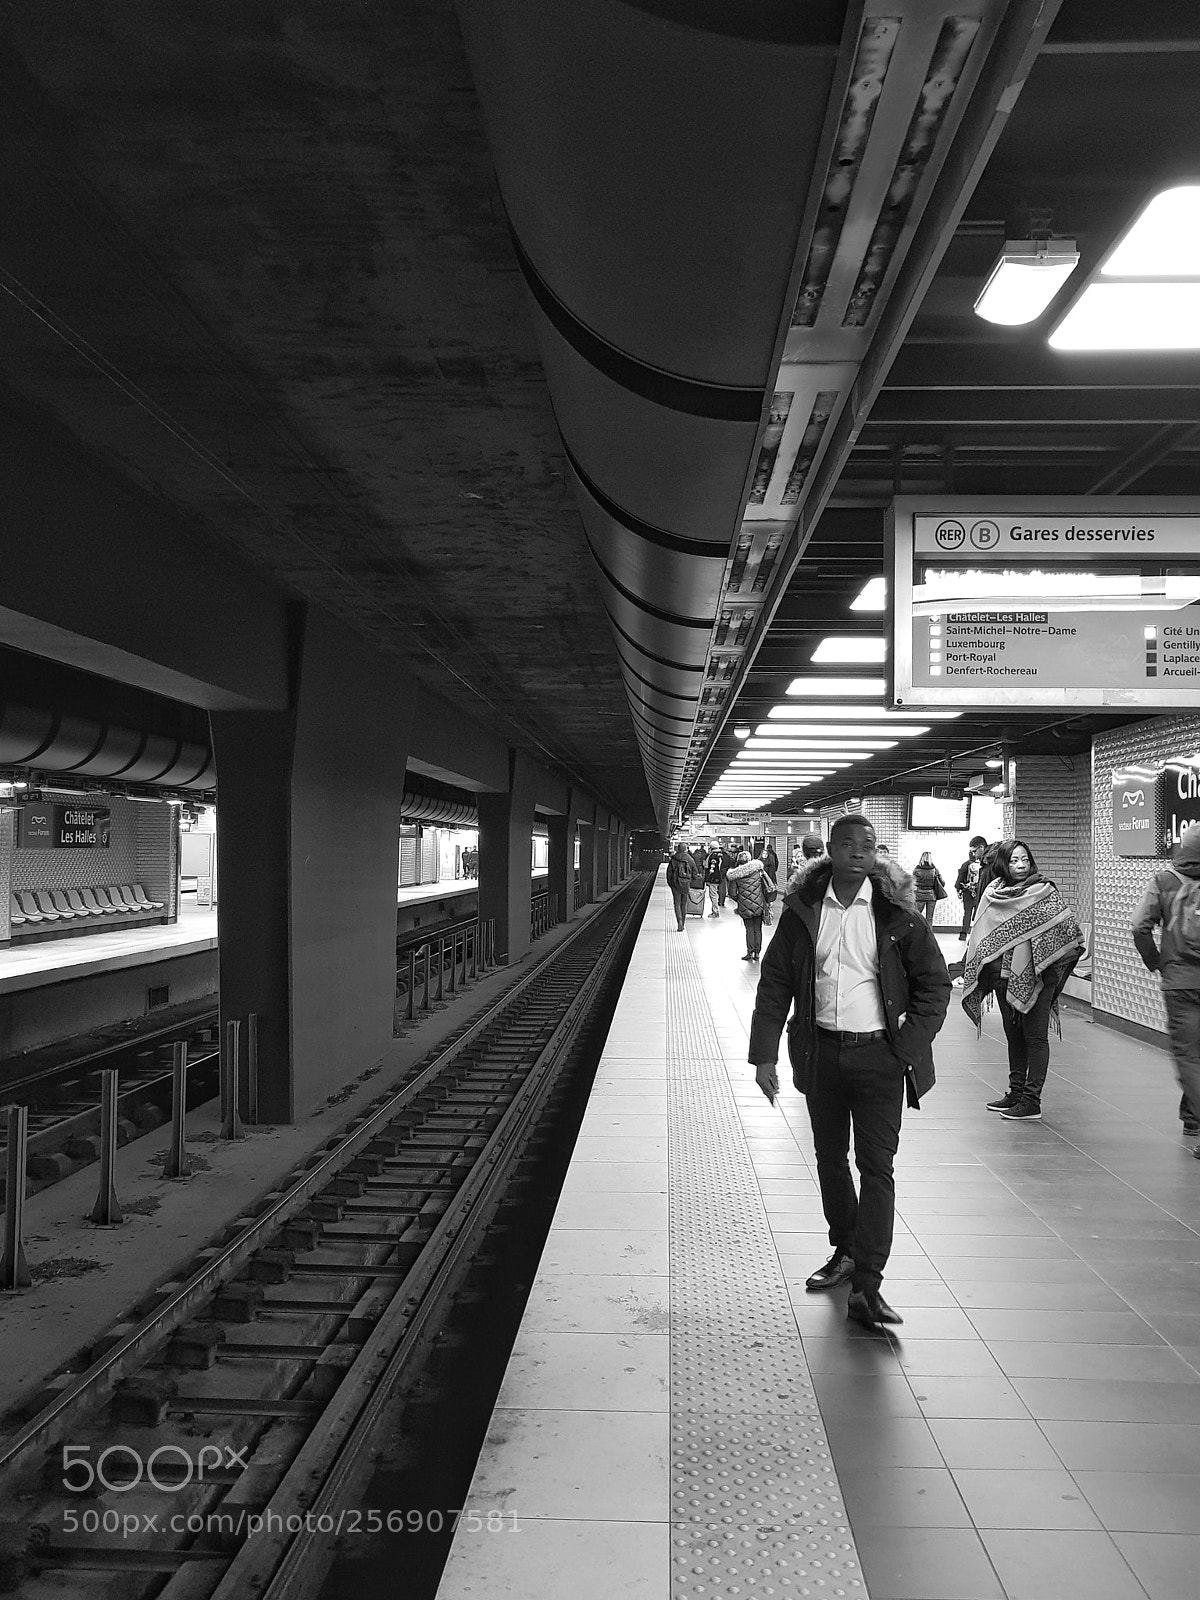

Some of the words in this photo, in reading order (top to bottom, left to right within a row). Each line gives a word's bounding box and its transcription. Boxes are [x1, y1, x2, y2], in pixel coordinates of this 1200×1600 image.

[939, 529, 962, 541] RER
[978, 527, 991, 543] B
[1009, 526, 1060, 541] Gares
[1065, 525, 1156, 541] desservies
[1016, 612, 1046, 622] Halles
[1163, 626, 1183, 636] Cité
[946, 639, 1006, 651] Luxembourg
[1163, 640, 1200, 652] Gentilly
[946, 652, 996, 664] Port-Royal
[1163, 653, 1200, 665] Laplace
[946, 665, 1038, 676] Denfert-Rochereau
[950, 790, 961, 798] 27
[64, 811, 95, 825] Châtelet
[1132, 816, 1150, 830] Forum
[61, 829, 74, 843] Les
[75, 829, 97, 843] Halles
